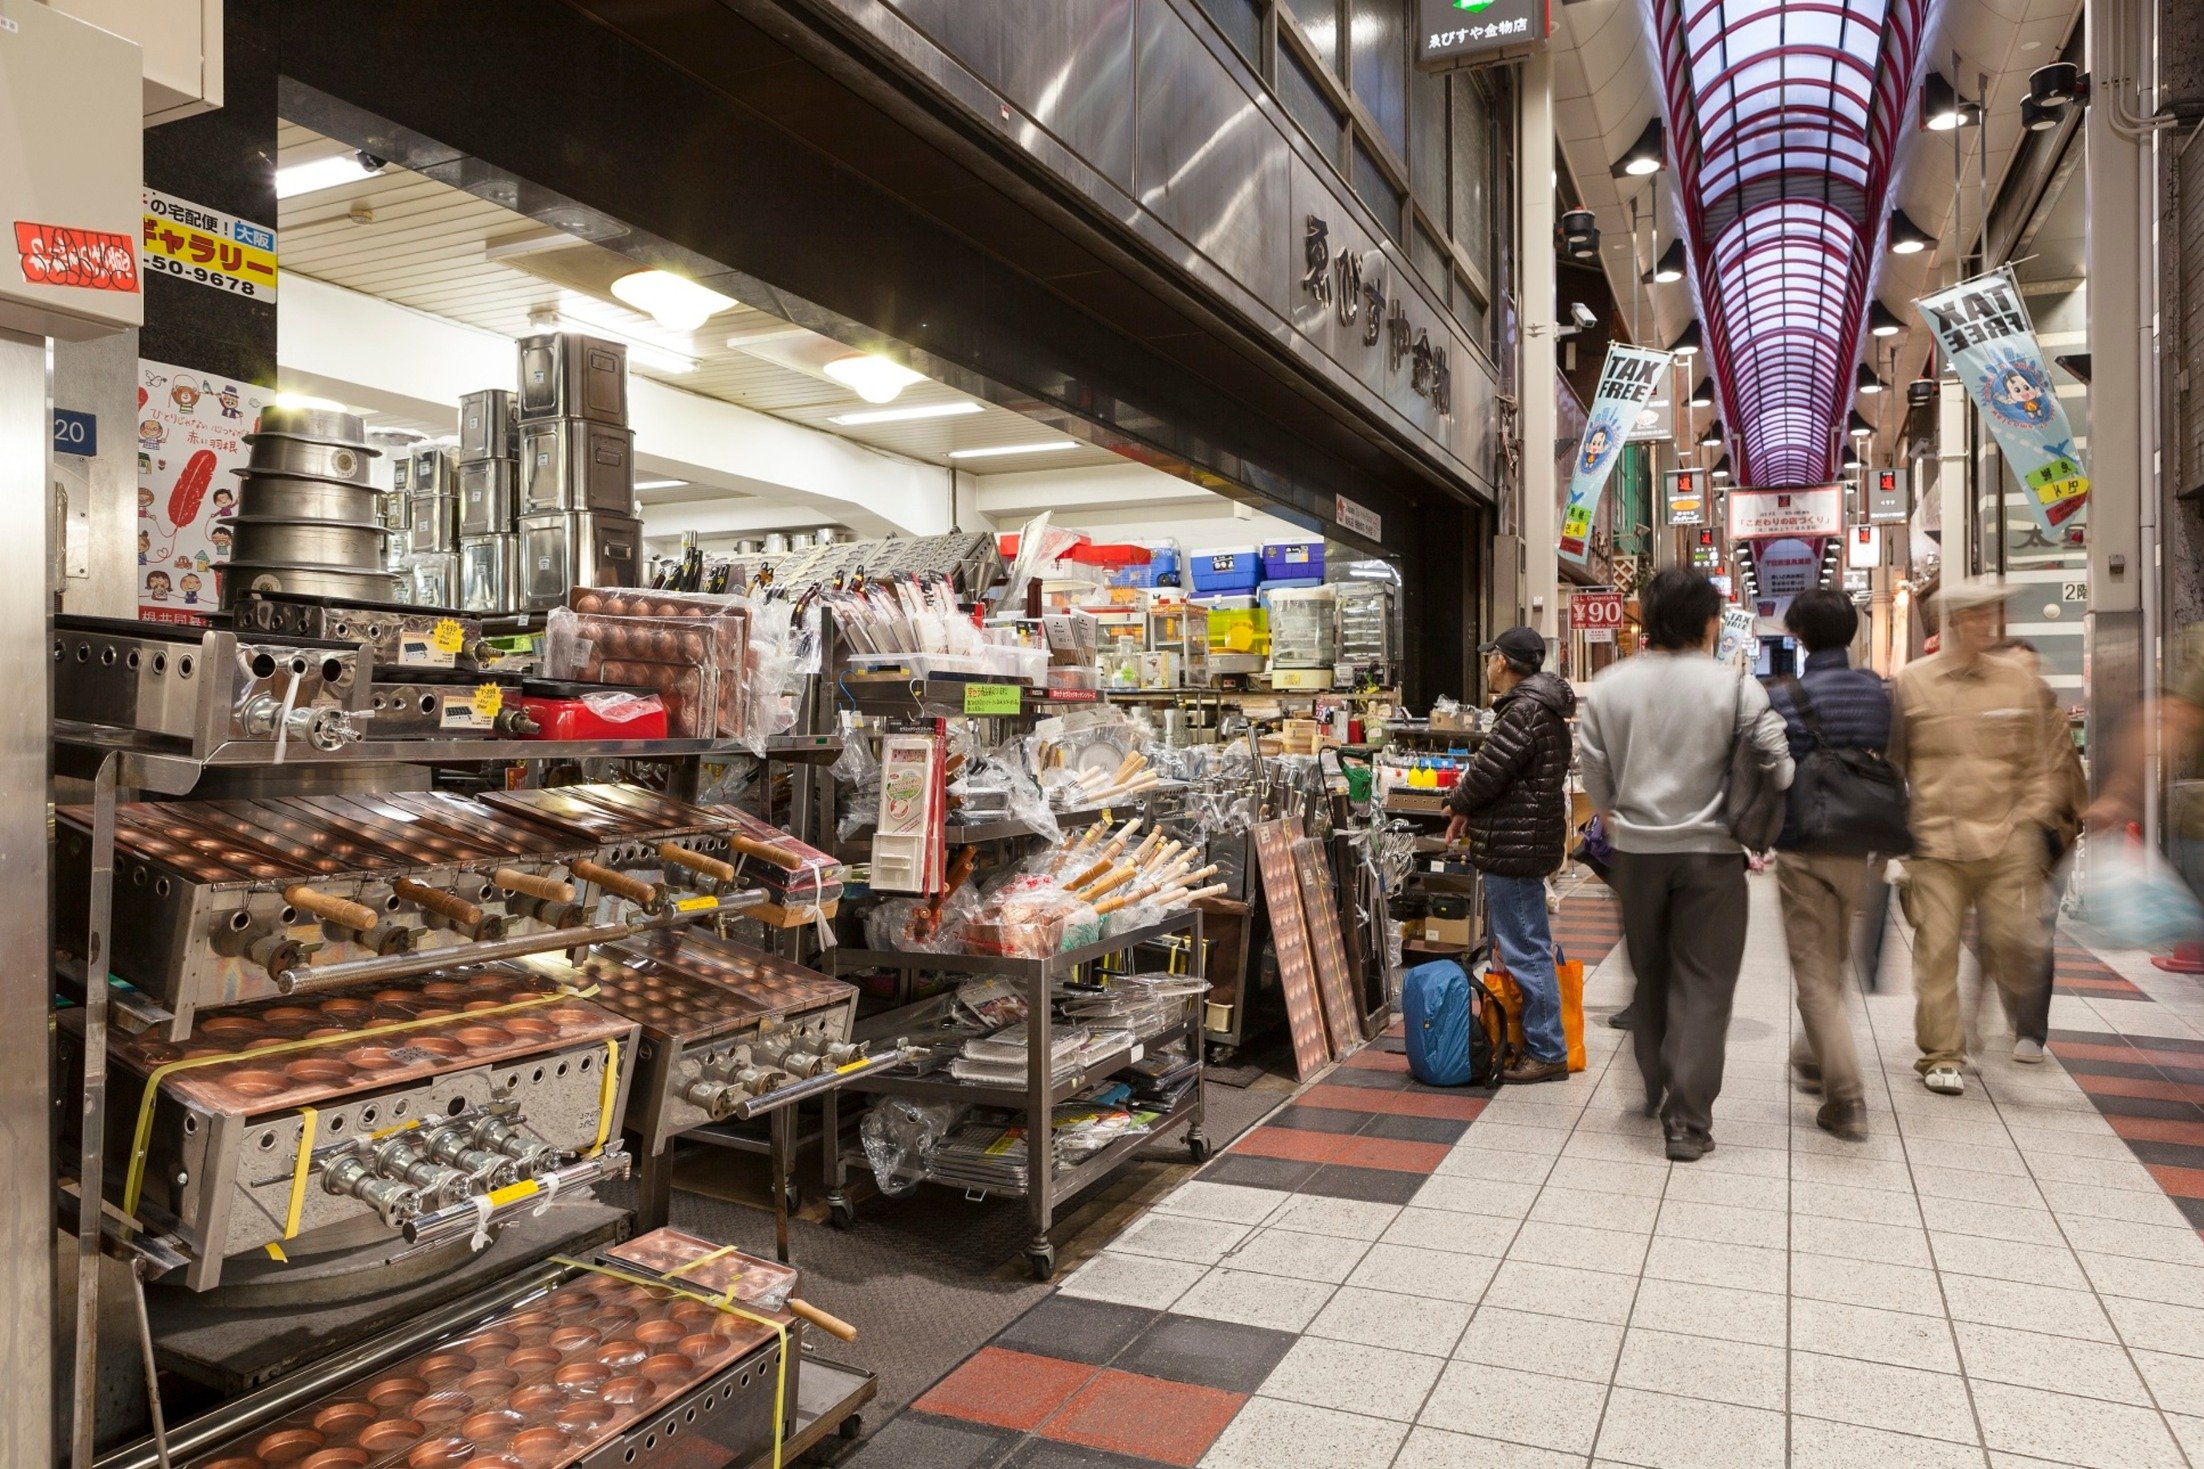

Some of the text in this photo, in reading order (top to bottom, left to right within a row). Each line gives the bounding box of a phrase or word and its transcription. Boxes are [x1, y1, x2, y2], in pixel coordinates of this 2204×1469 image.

[143, 193, 228, 235] の宅配便！
[236, 226, 270, 250] 大阪
[1606, 356, 1660, 384] TAX
[1598, 380, 1648, 403] FREE
[55, 418, 85, 443] 20
[187, 431, 238, 454] 赤い羽根
[1573, 602, 1621, 622] ¥90
